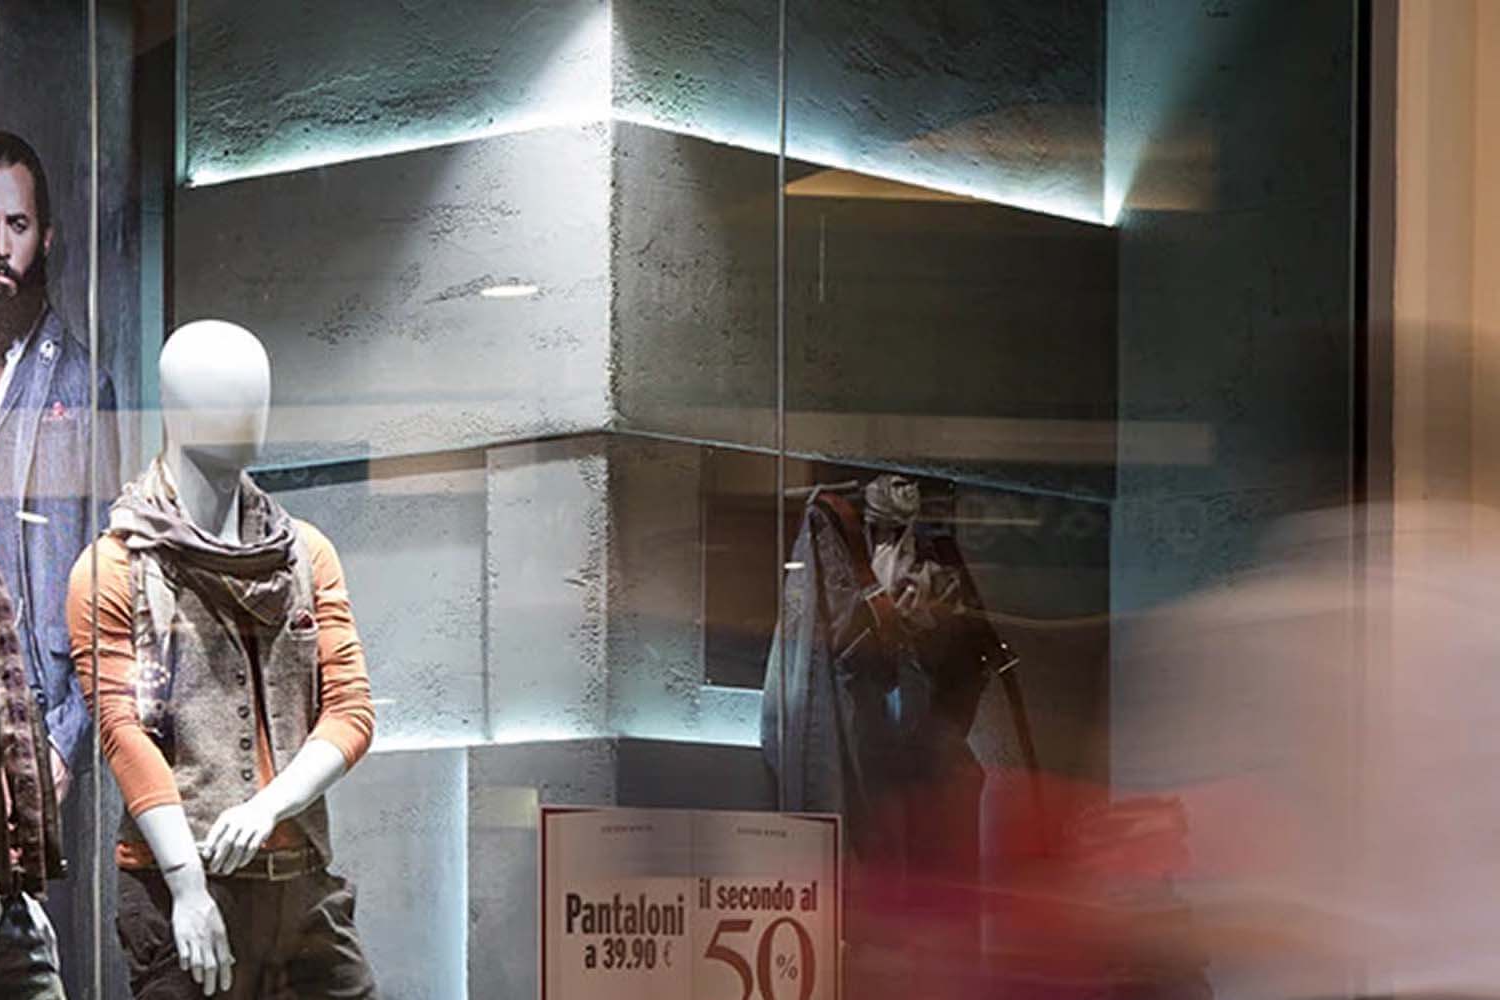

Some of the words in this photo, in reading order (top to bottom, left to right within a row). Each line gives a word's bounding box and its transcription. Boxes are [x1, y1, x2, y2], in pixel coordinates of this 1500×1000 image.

[699, 878, 711, 909] il
[716, 880, 794, 911] secondo
[801, 881, 817, 911] al
[565, 893, 685, 936] Pantaloni
[585, 944, 596, 969] a
[603, 938, 657, 970] 39.90
